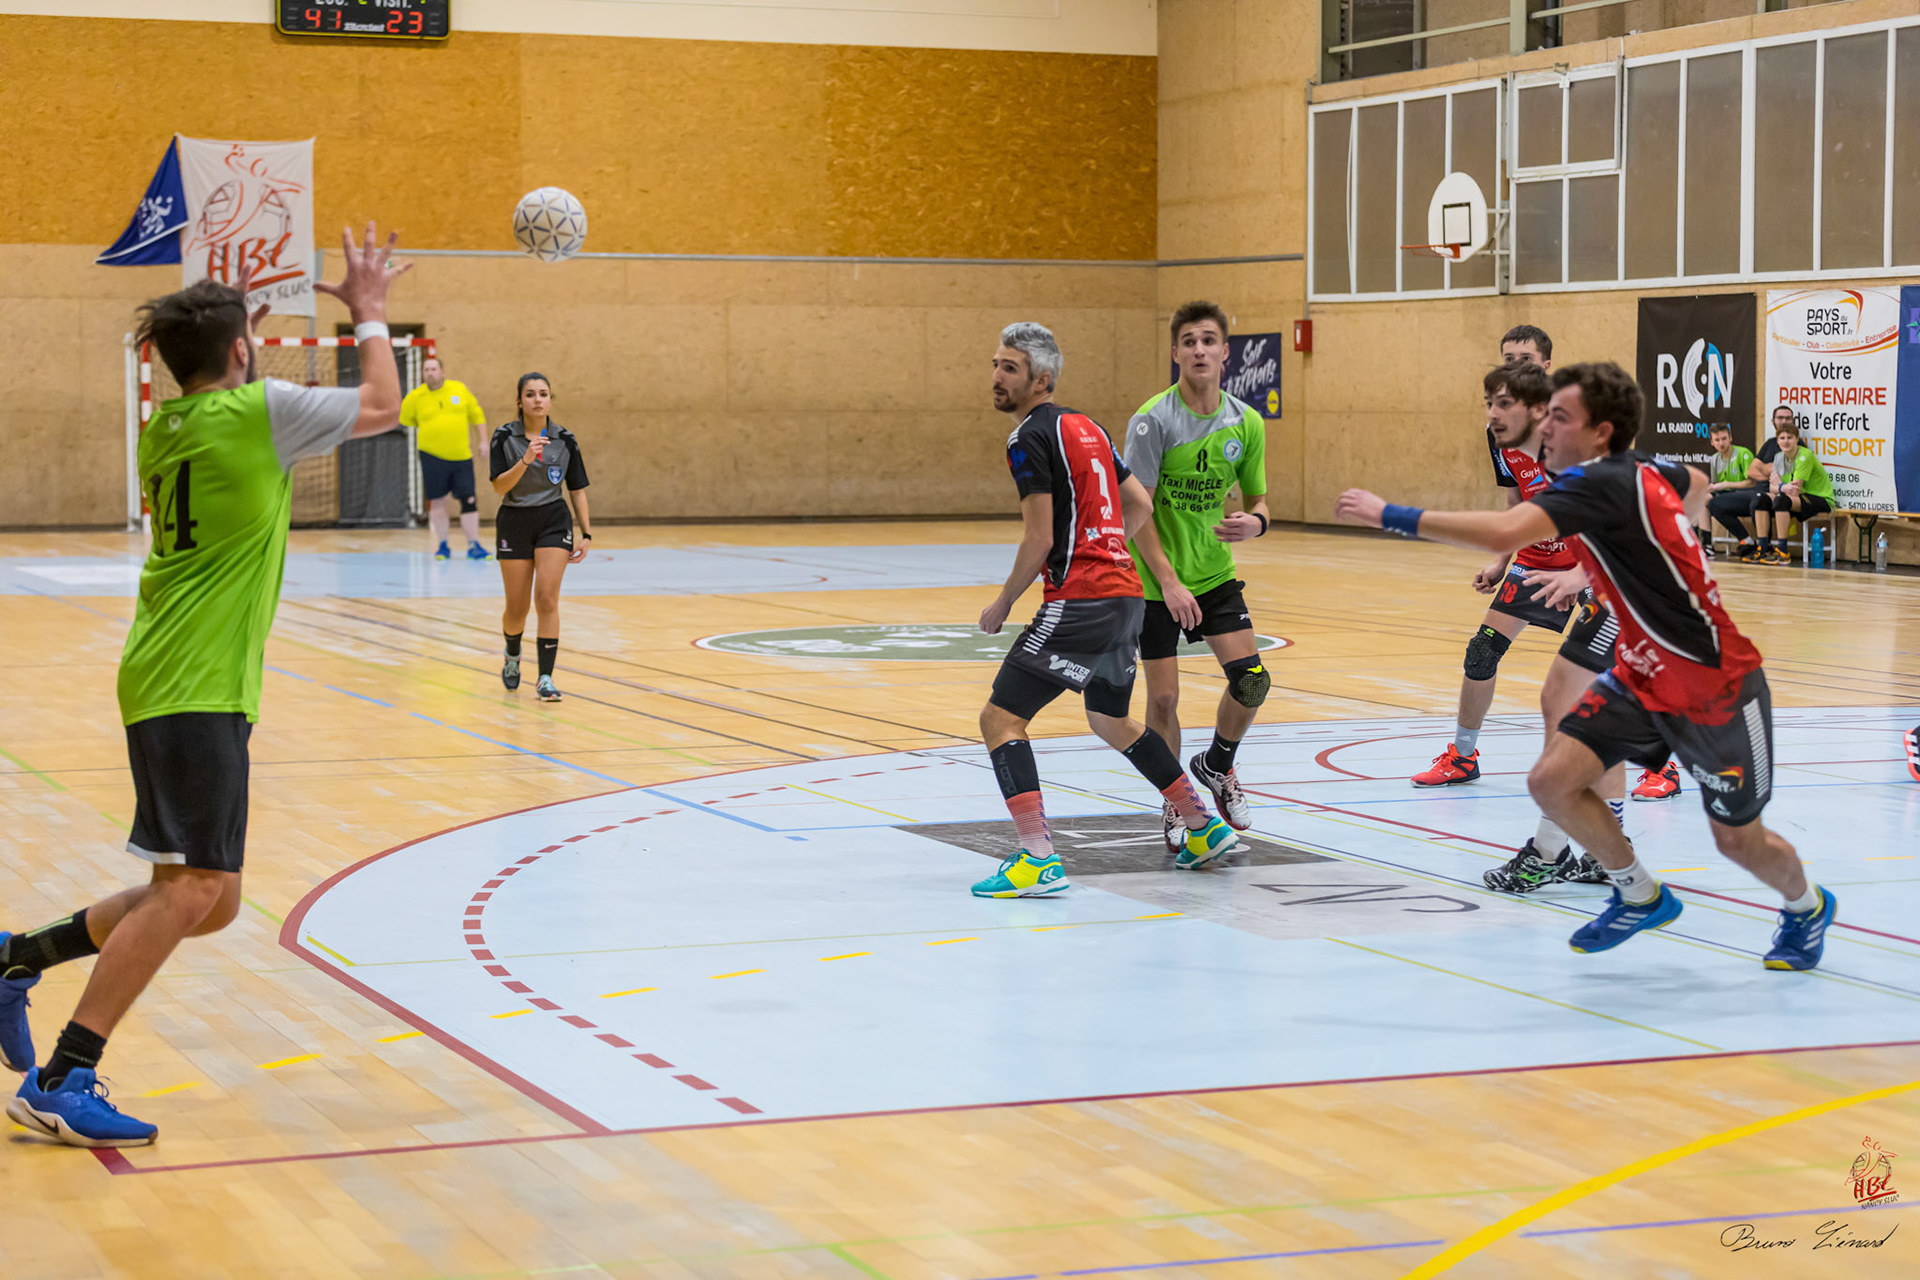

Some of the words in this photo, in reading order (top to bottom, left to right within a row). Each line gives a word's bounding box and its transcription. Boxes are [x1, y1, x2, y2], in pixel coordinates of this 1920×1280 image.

[305, 8, 342, 29] 41
[386, 10, 423, 34] 23
[1806, 308, 1840, 322] PAYS
[1806, 341, 1820, 349] Club
[1865, 324, 1897, 344] Entreprise
[1809, 361, 1852, 380] Votre
[1779, 386, 1887, 406] PARTENAIRE
[1656, 422, 1667, 433] LA
[1668, 422, 1694, 434] RADIO
[1794, 413, 1810, 430] de
[1815, 413, 1870, 431] l'effort
[1803, 437, 1886, 457] TISPORT
[1196, 448, 1208, 473] 8
[1683, 453, 1692, 463] du
[1162, 473, 1183, 489] Taxi
[1185, 478, 1224, 492] MICELE
[1520, 469, 1534, 479] Guy
[1835, 473, 1846, 482] 68
[1848, 474, 1860, 483] 06
[1868, 502, 1895, 512] LUDRES
[1066, 660, 1091, 676] INTER
